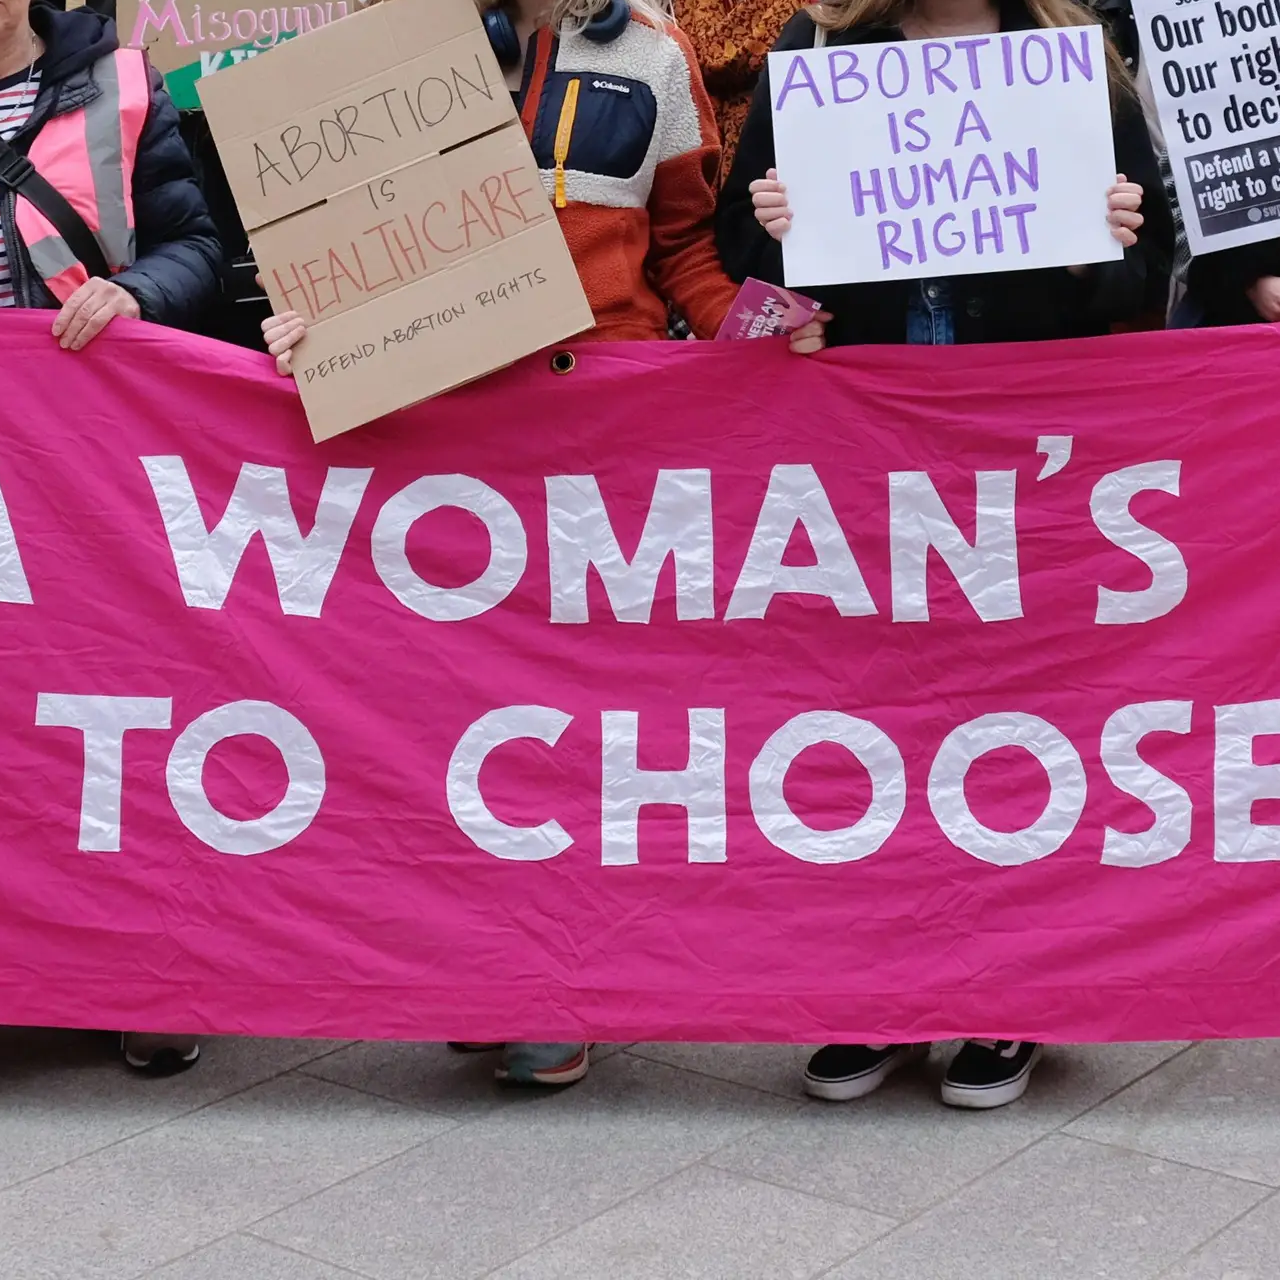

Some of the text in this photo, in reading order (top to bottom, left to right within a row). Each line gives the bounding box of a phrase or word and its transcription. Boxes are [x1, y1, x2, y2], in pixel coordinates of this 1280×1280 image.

[1150, 14, 1205, 52] Our
[600, 81, 630, 93] Columbia
[775, 30, 1093, 110] ABORTION
[1162, 59, 1218, 98] Our
[252, 53, 495, 197] ABORTION
[887, 100, 992, 154] IS A
[1177, 108, 1212, 144] to
[369, 179, 396, 210] IS
[850, 147, 1039, 217] HUMAN
[1189, 148, 1254, 183] Defend
[1258, 149, 1271, 168] a
[1198, 179, 1243, 212] right
[1245, 176, 1267, 199] to
[273, 166, 547, 319] HEALTHCARE
[877, 203, 1037, 270] RIGHT
[304, 268, 548, 384] DEFEND ABORTION RIGHTS
[139, 435, 1188, 625] WOMAN'S
[35, 692, 326, 856] TO
